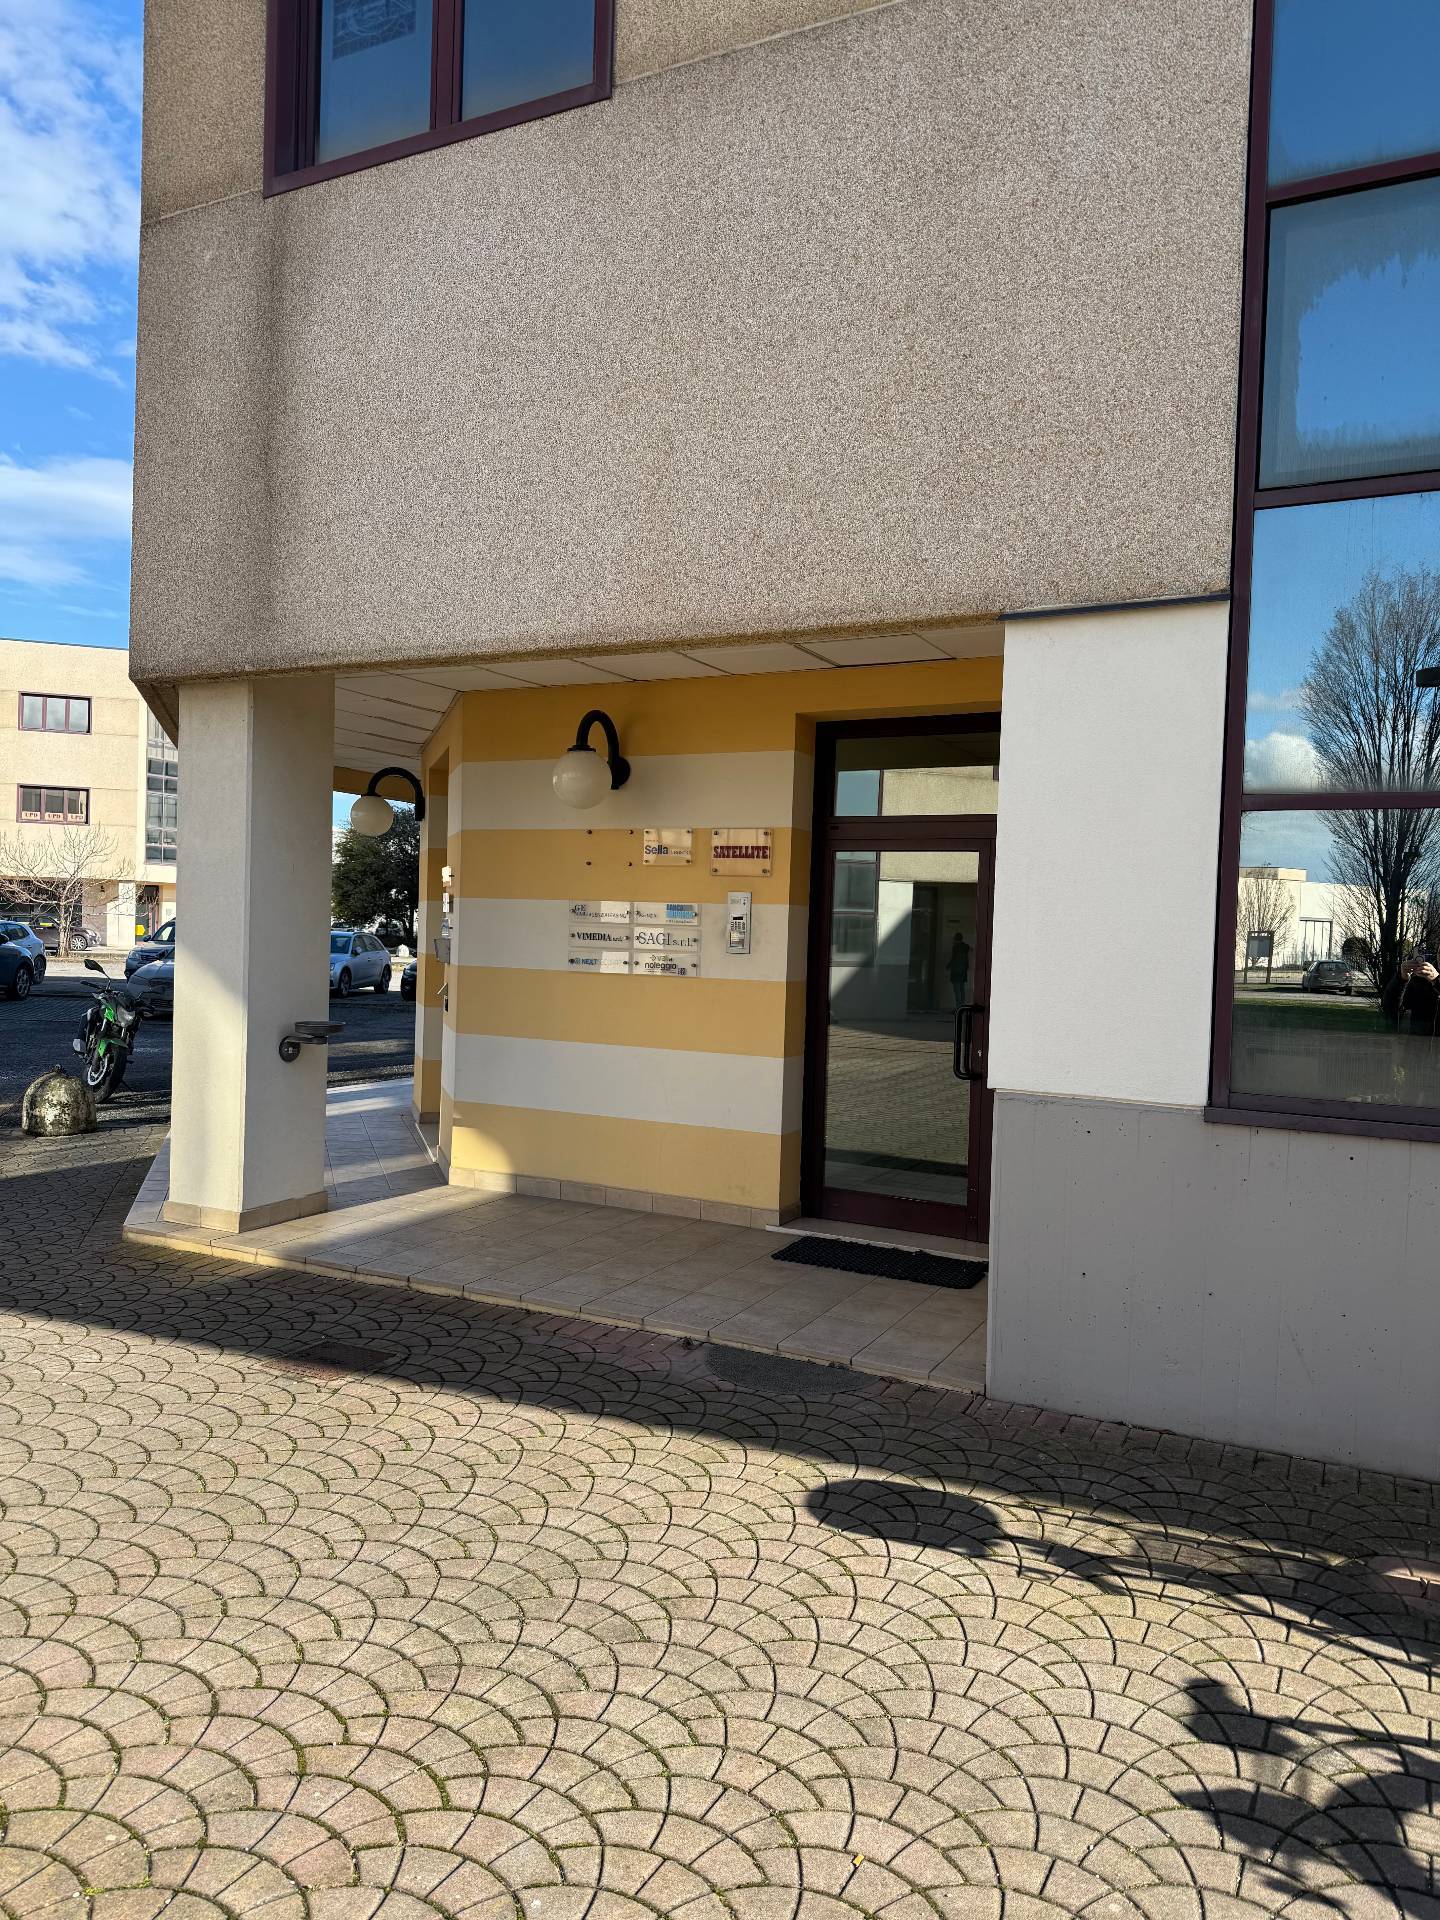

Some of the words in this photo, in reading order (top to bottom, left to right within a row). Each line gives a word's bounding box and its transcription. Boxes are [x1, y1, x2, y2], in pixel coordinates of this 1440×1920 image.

[644, 844, 669, 855] Sella
[713, 845, 769, 859] SATELLITE
[576, 931, 612, 941] VIMEDIA
[638, 931, 671, 946] SAGI
[644, 961, 677, 971] noleggio
